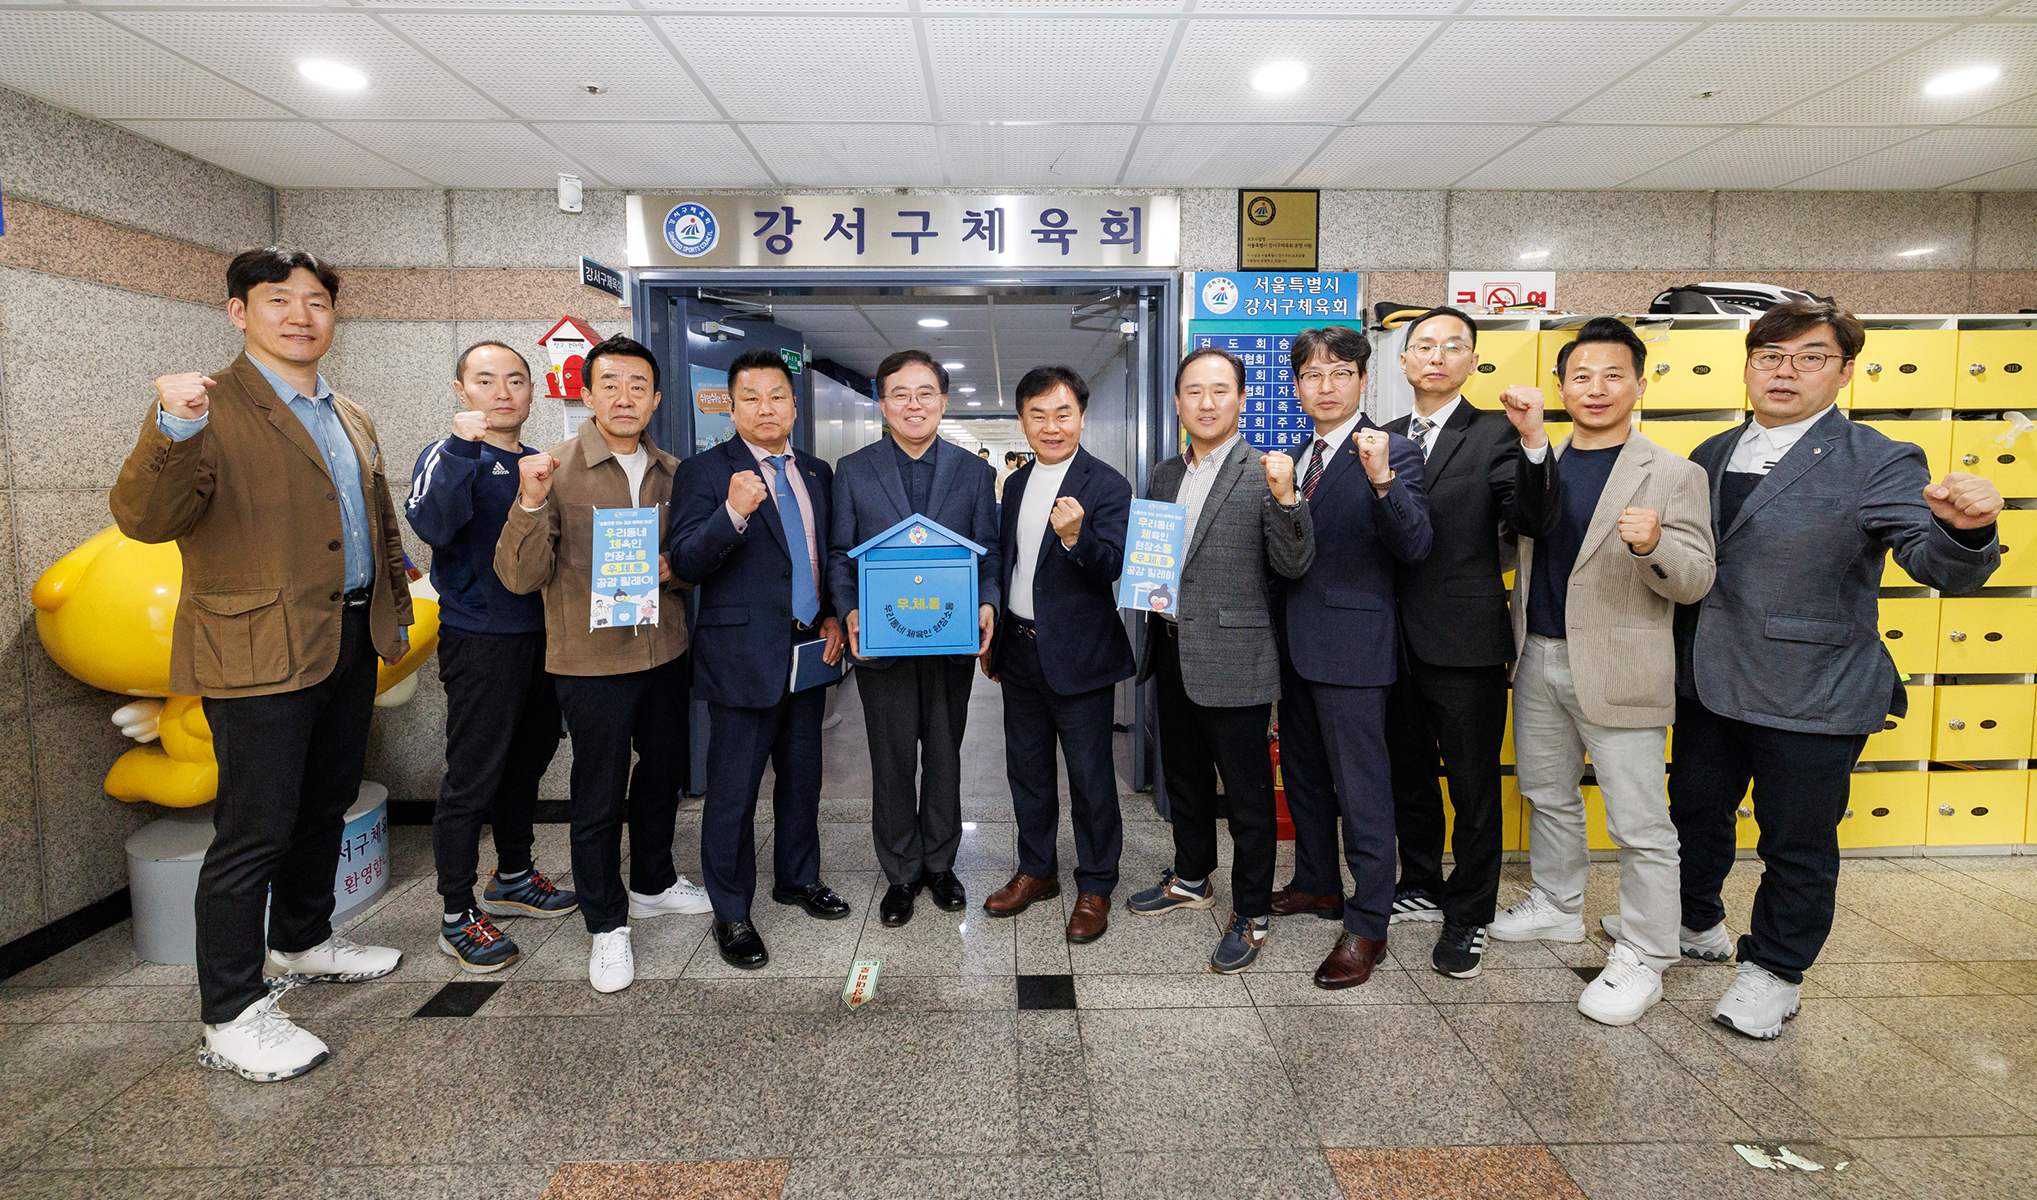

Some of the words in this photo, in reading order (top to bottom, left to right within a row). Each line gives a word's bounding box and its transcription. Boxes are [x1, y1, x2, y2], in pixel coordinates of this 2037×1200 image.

[753, 206, 1141, 256] 강서구체육회
[1253, 276, 1340, 295] 서울특별시
[1243, 297, 1349, 316] 강서구체육회
[1138, 517, 1175, 531] 우리동네
[604, 527, 647, 538] 우리동네
[1140, 529, 1169, 542] 체육인
[609, 538, 642, 549] 체육인
[1135, 540, 1172, 554] 현장소통
[604, 550, 647, 562] 현장소통
[1127, 565, 1146, 577] 공감
[1147, 568, 1175, 581] 릴레이
[596, 577, 618, 588] 공감
[620, 575, 654, 587] 릴레이
[884, 604, 906, 635] 우리동네
[906, 628, 933, 639] 체육인
[932, 602, 954, 633] 현장소통
[851, 966, 871, 1004] 비상대피로
